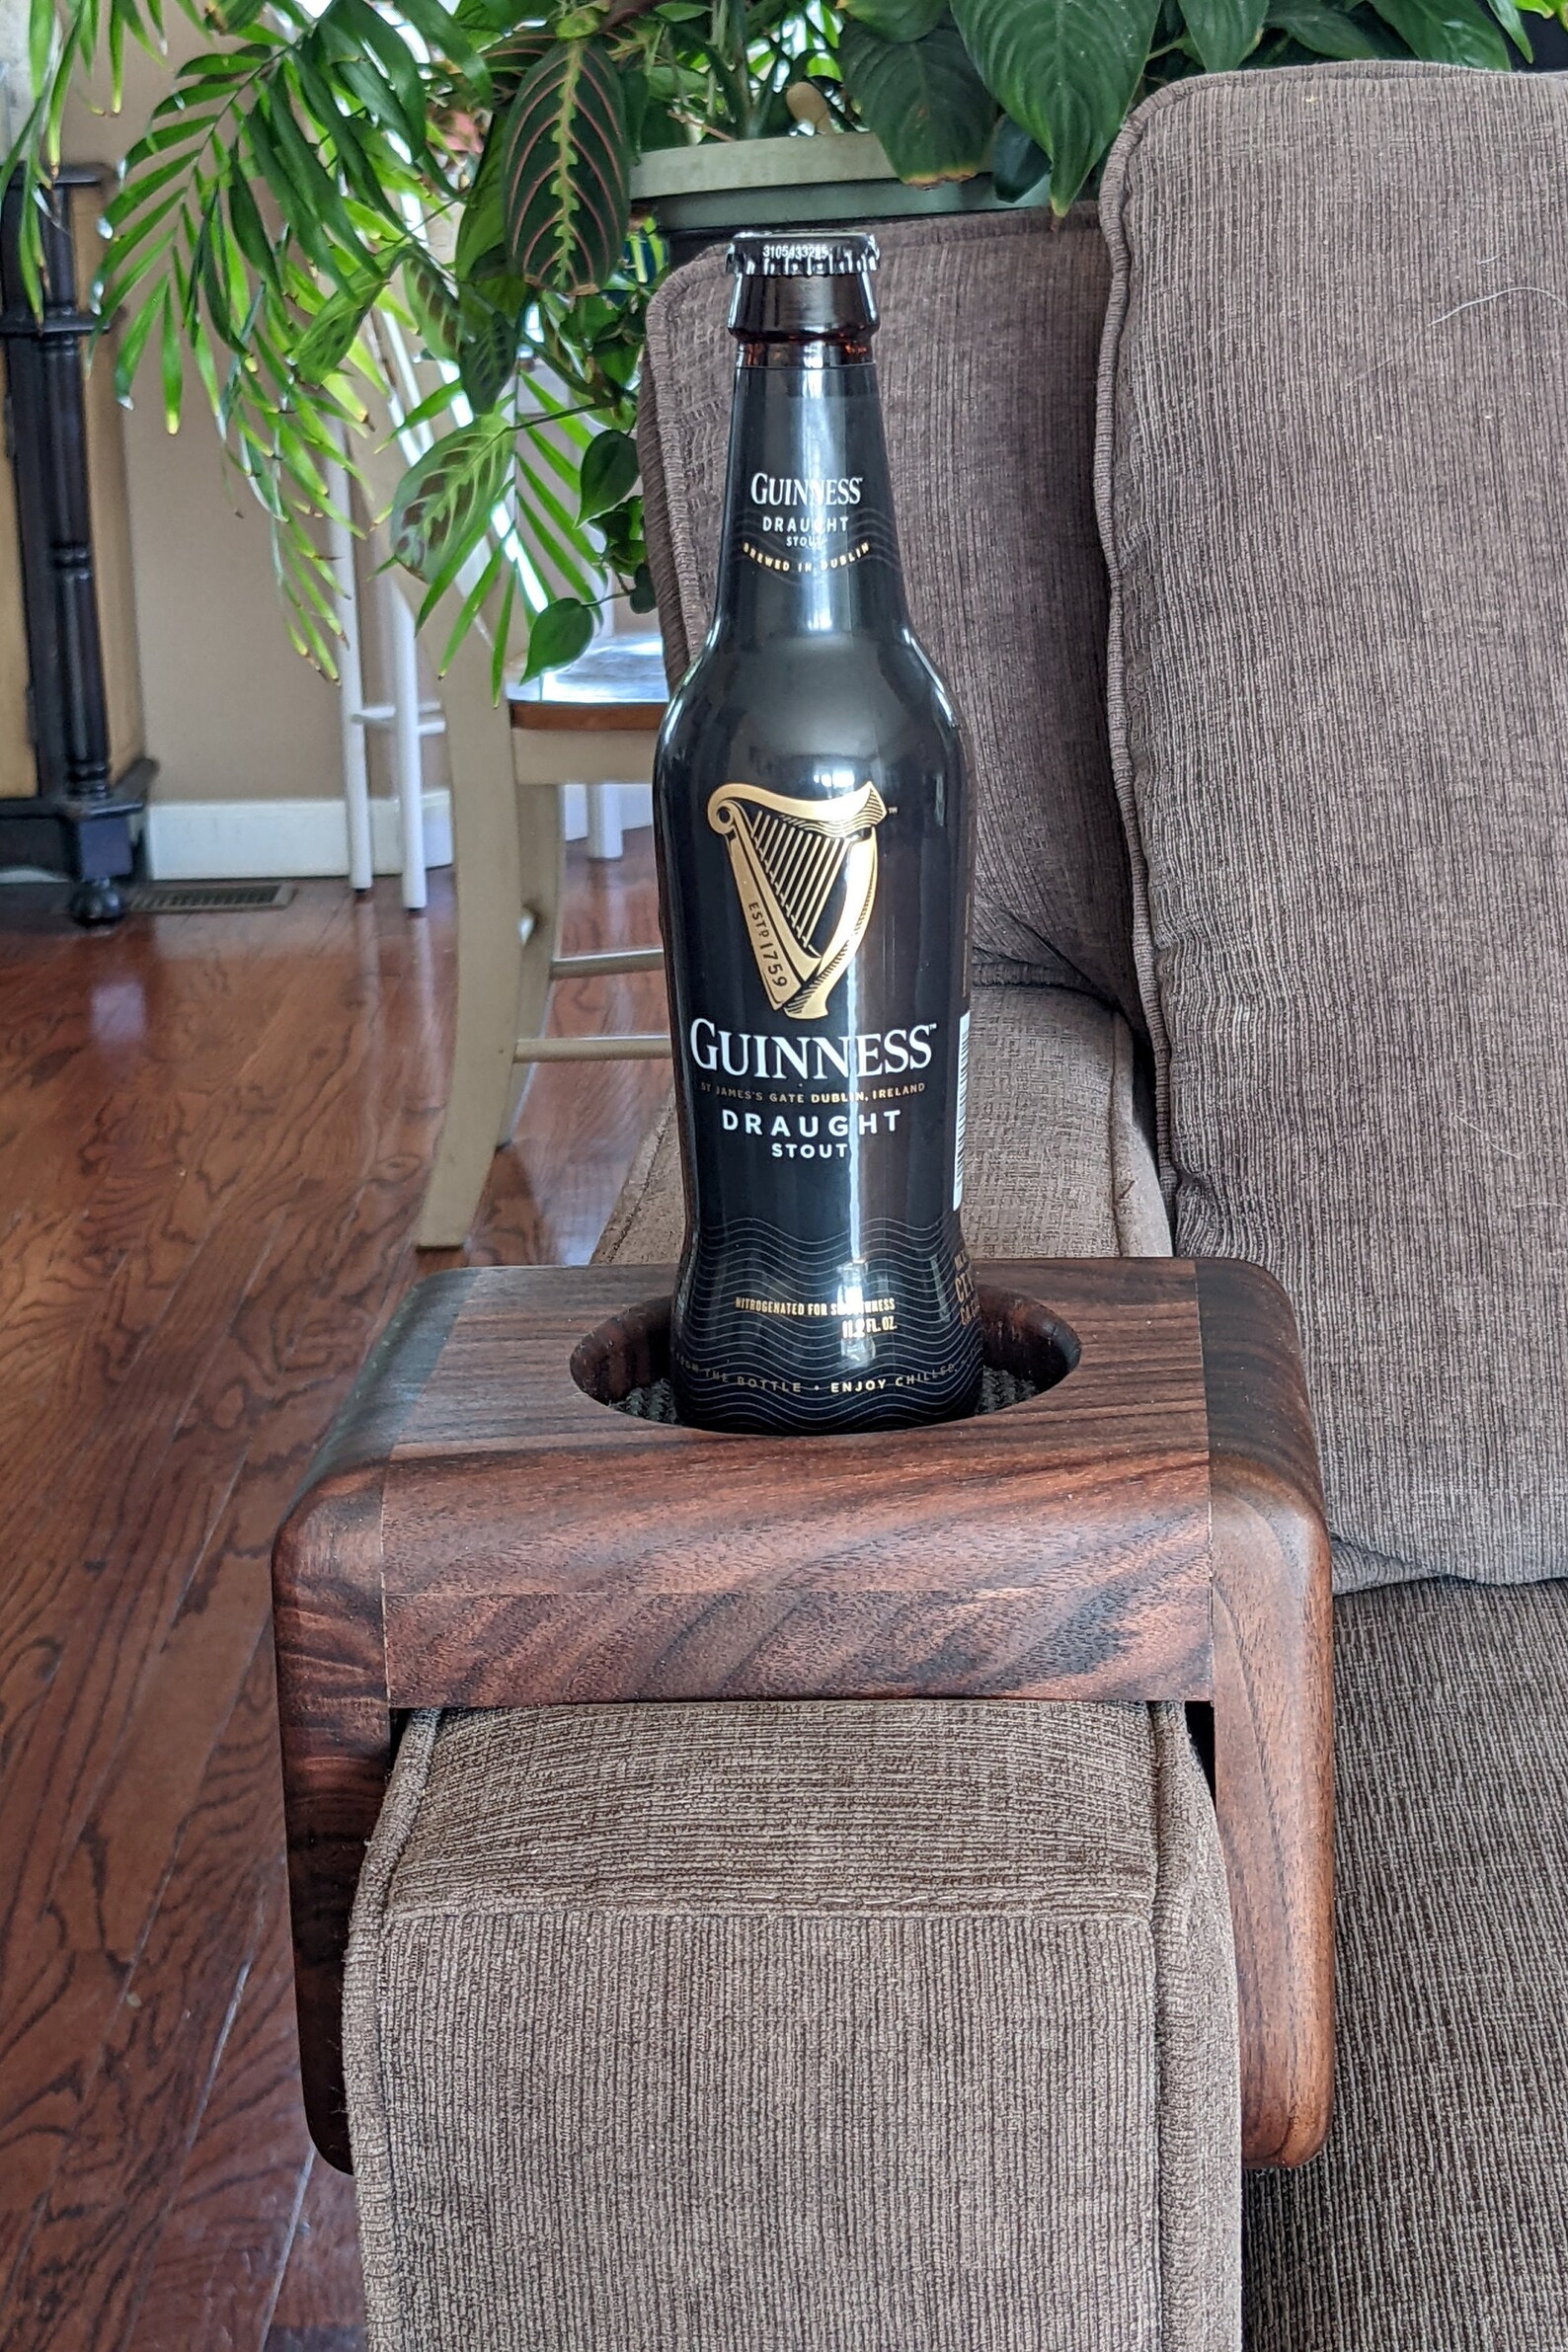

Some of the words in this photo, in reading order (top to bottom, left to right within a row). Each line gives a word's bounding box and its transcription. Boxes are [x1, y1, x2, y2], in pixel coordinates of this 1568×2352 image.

[750, 473, 863, 506] GUINNESS
[762, 515, 849, 533] DRAUGHT
[742, 542, 790, 572] BREWED
[798, 562, 813, 573] IN
[821, 541, 870, 571] DUBLIN
[760, 942, 788, 987] 1759
[690, 1018, 934, 1080] GUINNESS
[701, 1082, 711, 1092] ST
[716, 1085, 763, 1102] JAMES'S
[769, 1092, 805, 1104] GATE
[872, 1082, 926, 1100] IRELAND
[722, 1109, 902, 1137] DRAUGHT
[771, 1142, 848, 1158] STOUT
[735, 1296, 805, 1316] NITROGENATED
[808, 1301, 827, 1316] FOR
[705, 1369, 729, 1383] THE
[737, 1375, 802, 1393] BOTTLE
[830, 1378, 887, 1393] ENJOY
